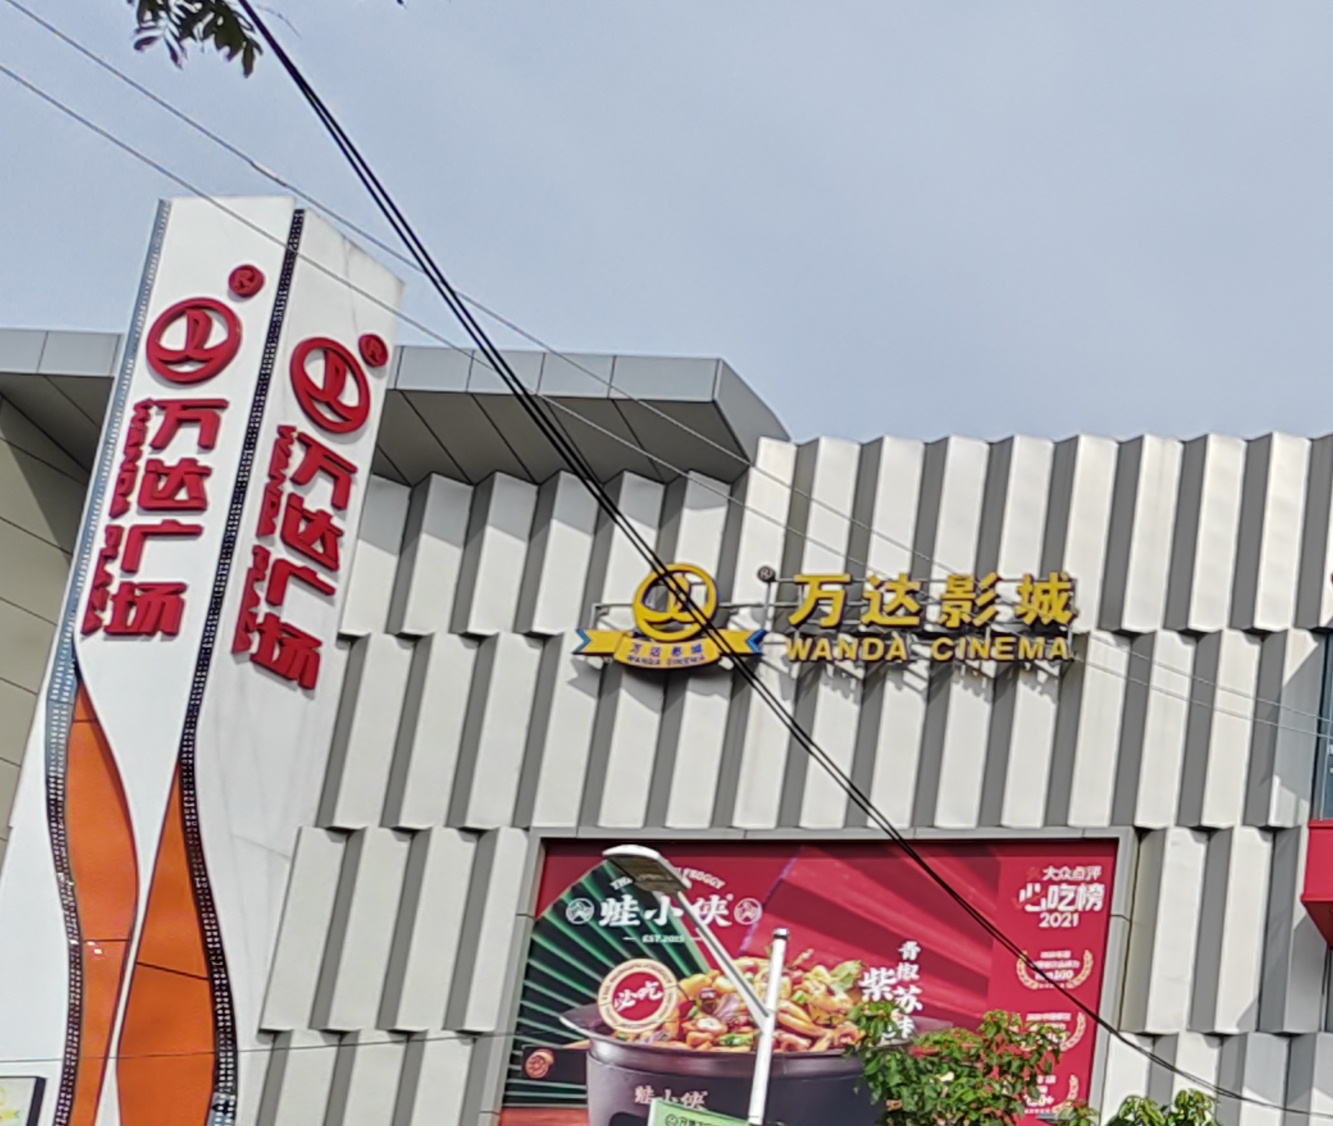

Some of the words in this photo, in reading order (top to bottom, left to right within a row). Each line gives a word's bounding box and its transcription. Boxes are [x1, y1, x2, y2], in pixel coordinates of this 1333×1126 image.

[104, 398, 229, 637] 万达广场
[250, 430, 357, 690] 万达广场
[788, 571, 1077, 628] 万达影城
[785, 637, 908, 661] WANDA
[931, 637, 1070, 661] CINEMA
[1042, 865, 1102, 881] 大众点评
[1018, 882, 1105, 912] 必吃榜
[1038, 912, 1079, 929] 2021
